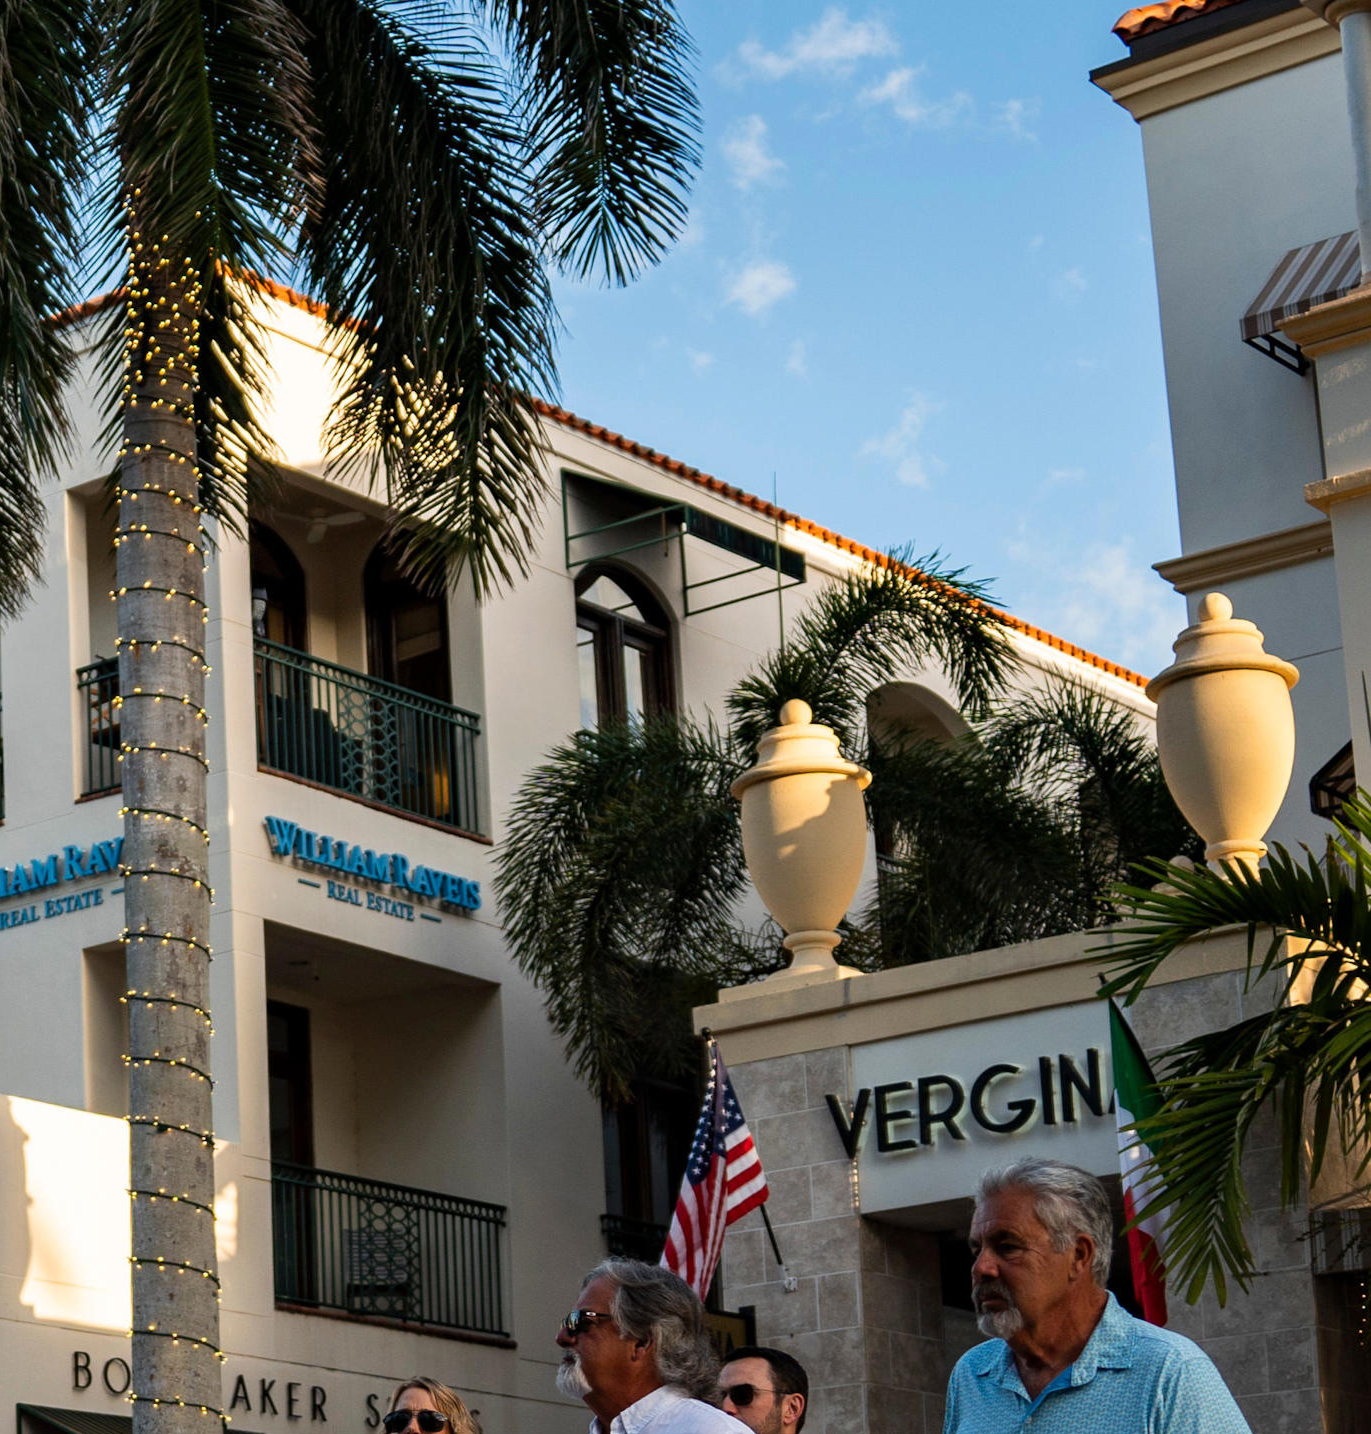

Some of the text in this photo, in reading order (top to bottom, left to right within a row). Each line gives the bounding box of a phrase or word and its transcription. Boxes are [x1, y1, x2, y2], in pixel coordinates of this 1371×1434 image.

[62, 835, 126, 881] RAV
[264, 815, 482, 911] WILLIAM RAVEIS
[44, 888, 104, 919] ESTATE
[327, 879, 415, 921] REAL ESTATE
[824, 1047, 1116, 1160] VERGIN
[229, 1373, 327, 1422] AKER
